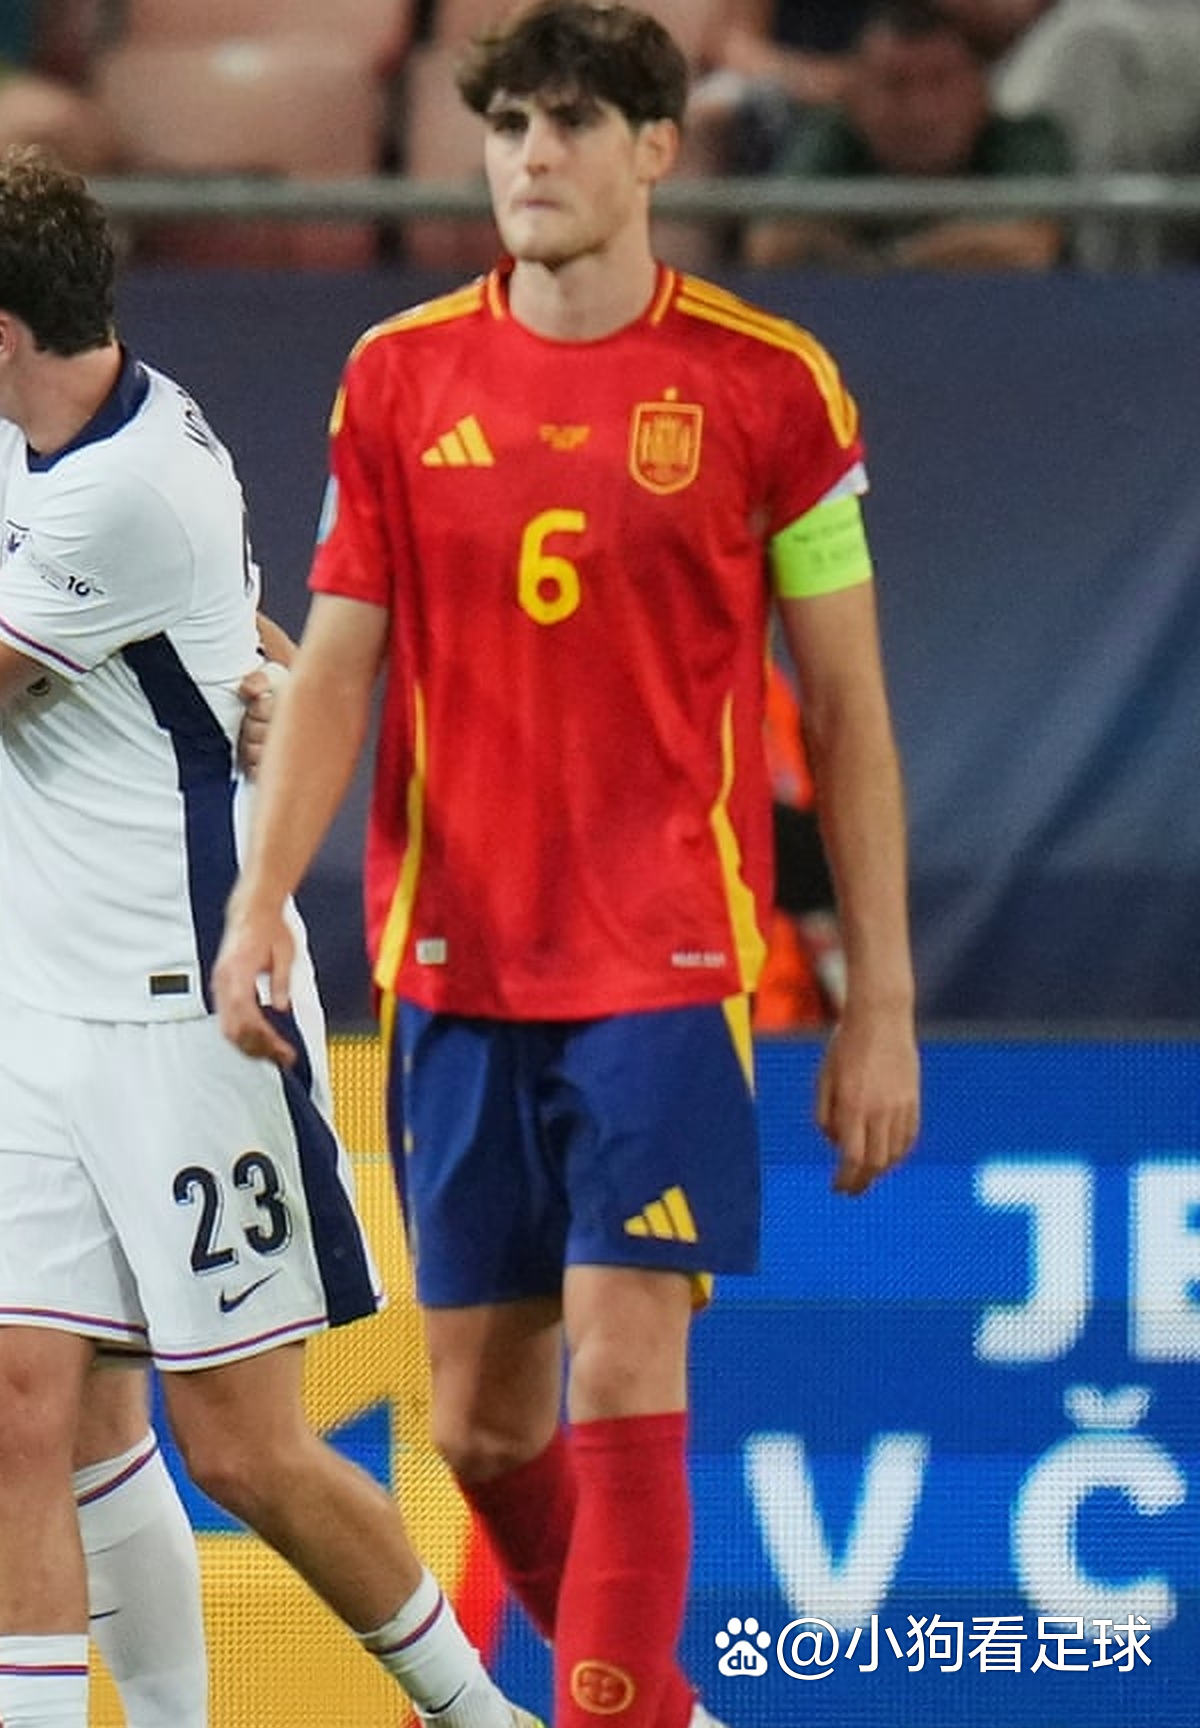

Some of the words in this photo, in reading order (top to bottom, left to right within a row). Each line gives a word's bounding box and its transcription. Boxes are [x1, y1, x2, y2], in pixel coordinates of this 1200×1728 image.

[517, 508, 587, 625] 6
[172, 1150, 293, 1275] 23
[743, 1431, 930, 1633] V
[1011, 1383, 1189, 1640] Č
